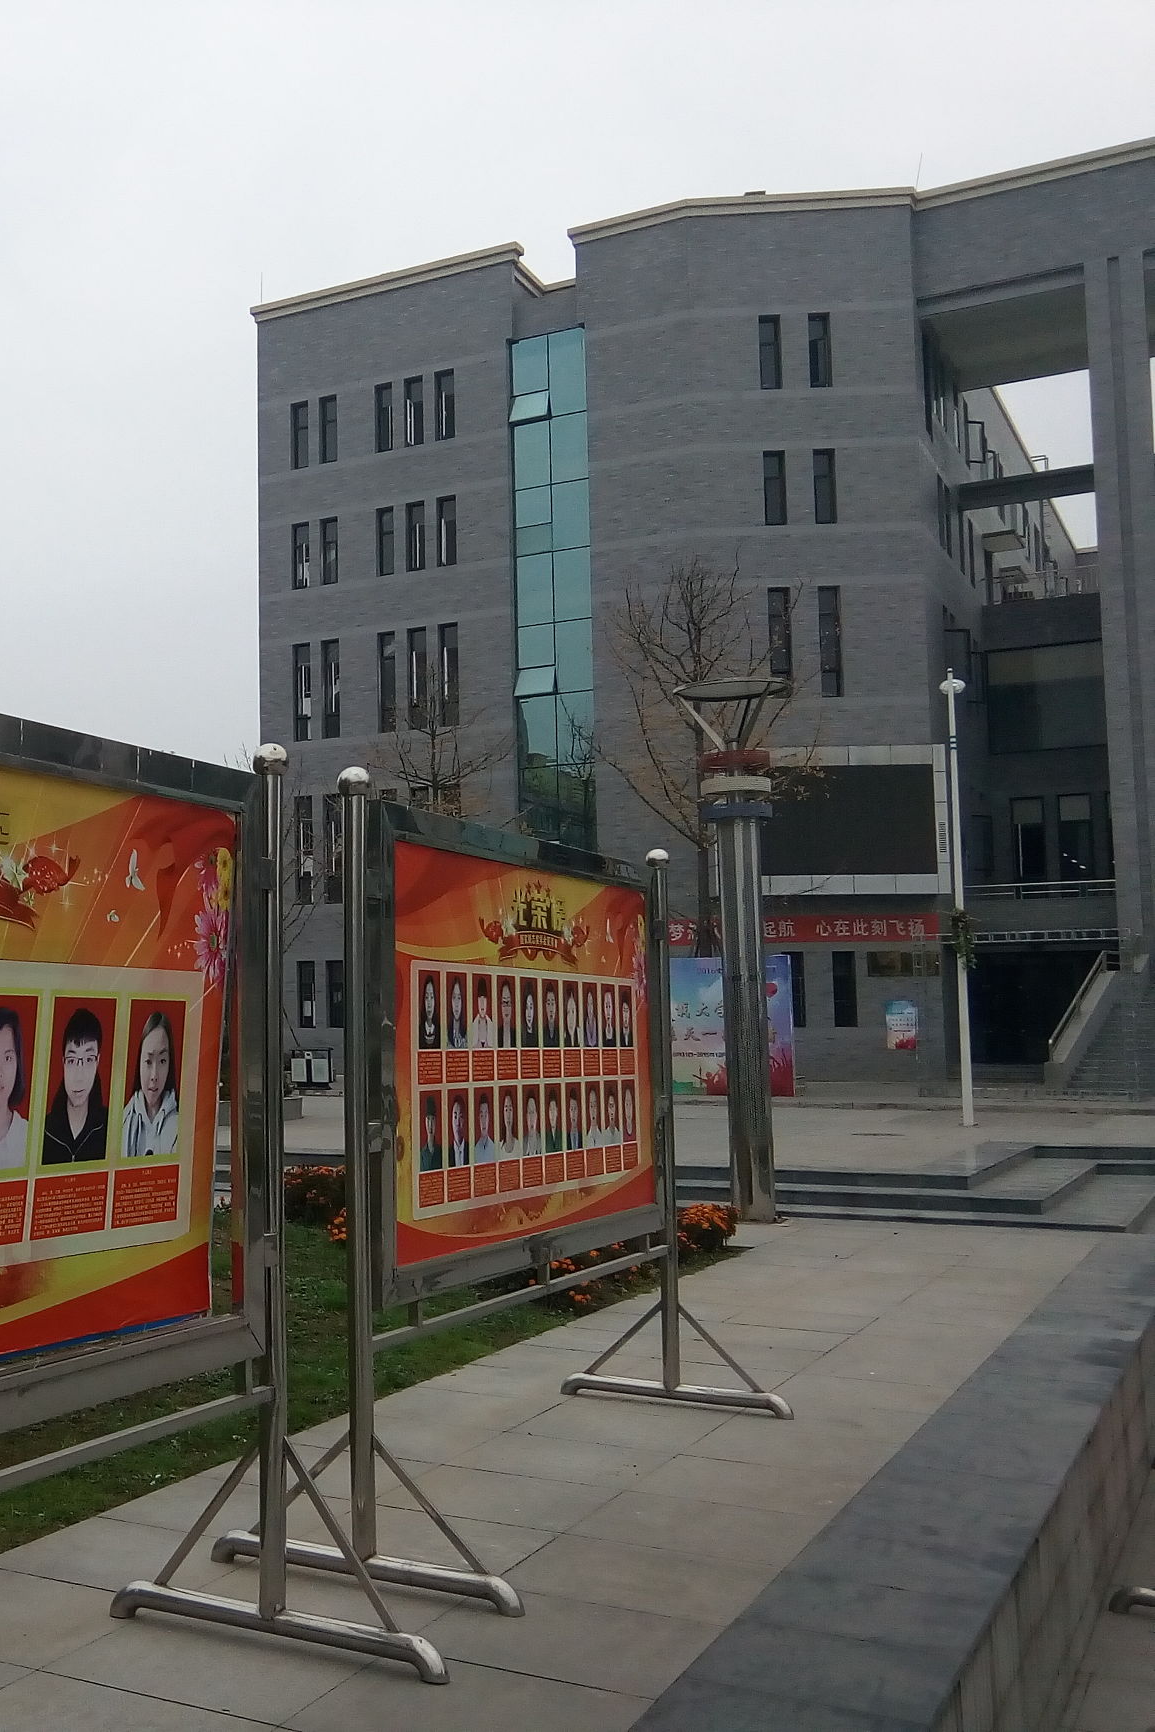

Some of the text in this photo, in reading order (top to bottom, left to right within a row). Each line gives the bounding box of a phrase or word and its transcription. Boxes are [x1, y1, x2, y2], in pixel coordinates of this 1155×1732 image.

[816, 919, 925, 937] 心在此刻飞扬
